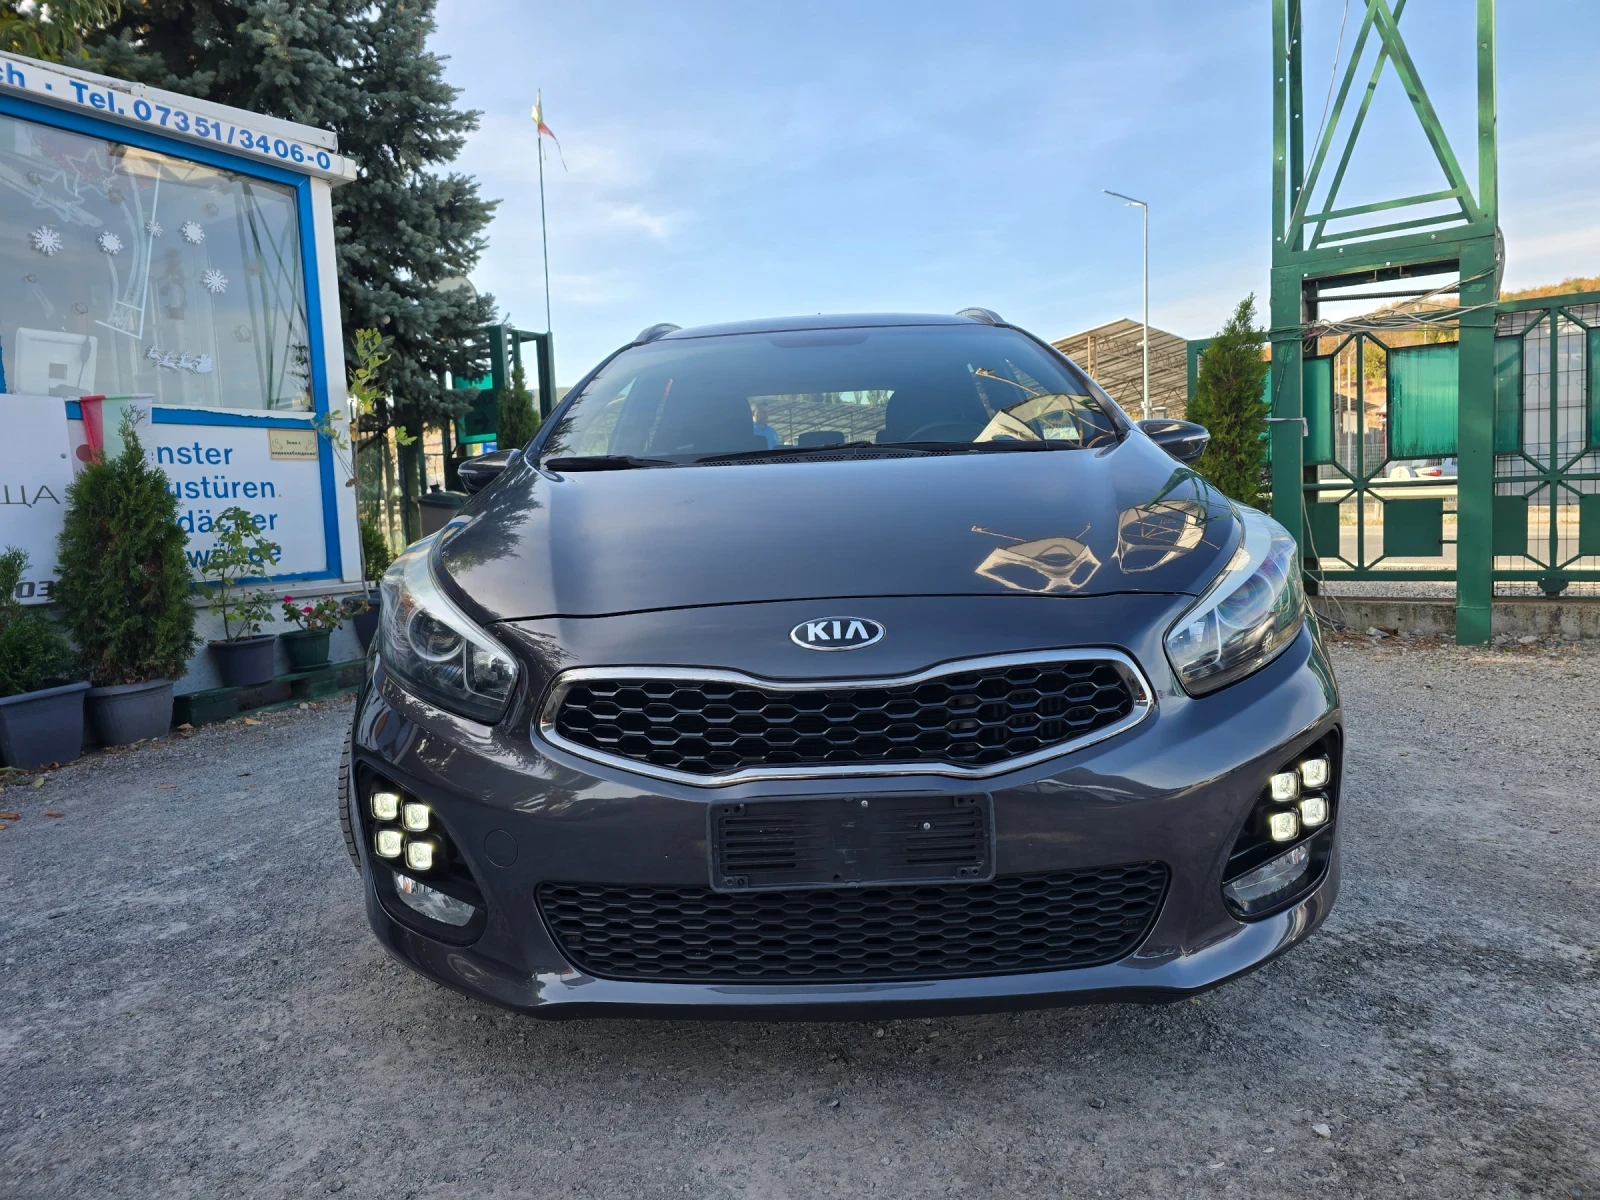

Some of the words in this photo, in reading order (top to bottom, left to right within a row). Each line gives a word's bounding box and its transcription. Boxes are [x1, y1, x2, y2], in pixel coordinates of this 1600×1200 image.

[69, 81, 125, 115] Tel.
[133, 99, 331, 171] 07351/3406-0
[151, 442, 233, 465] nster
[806, 620, 870, 642] KIA
